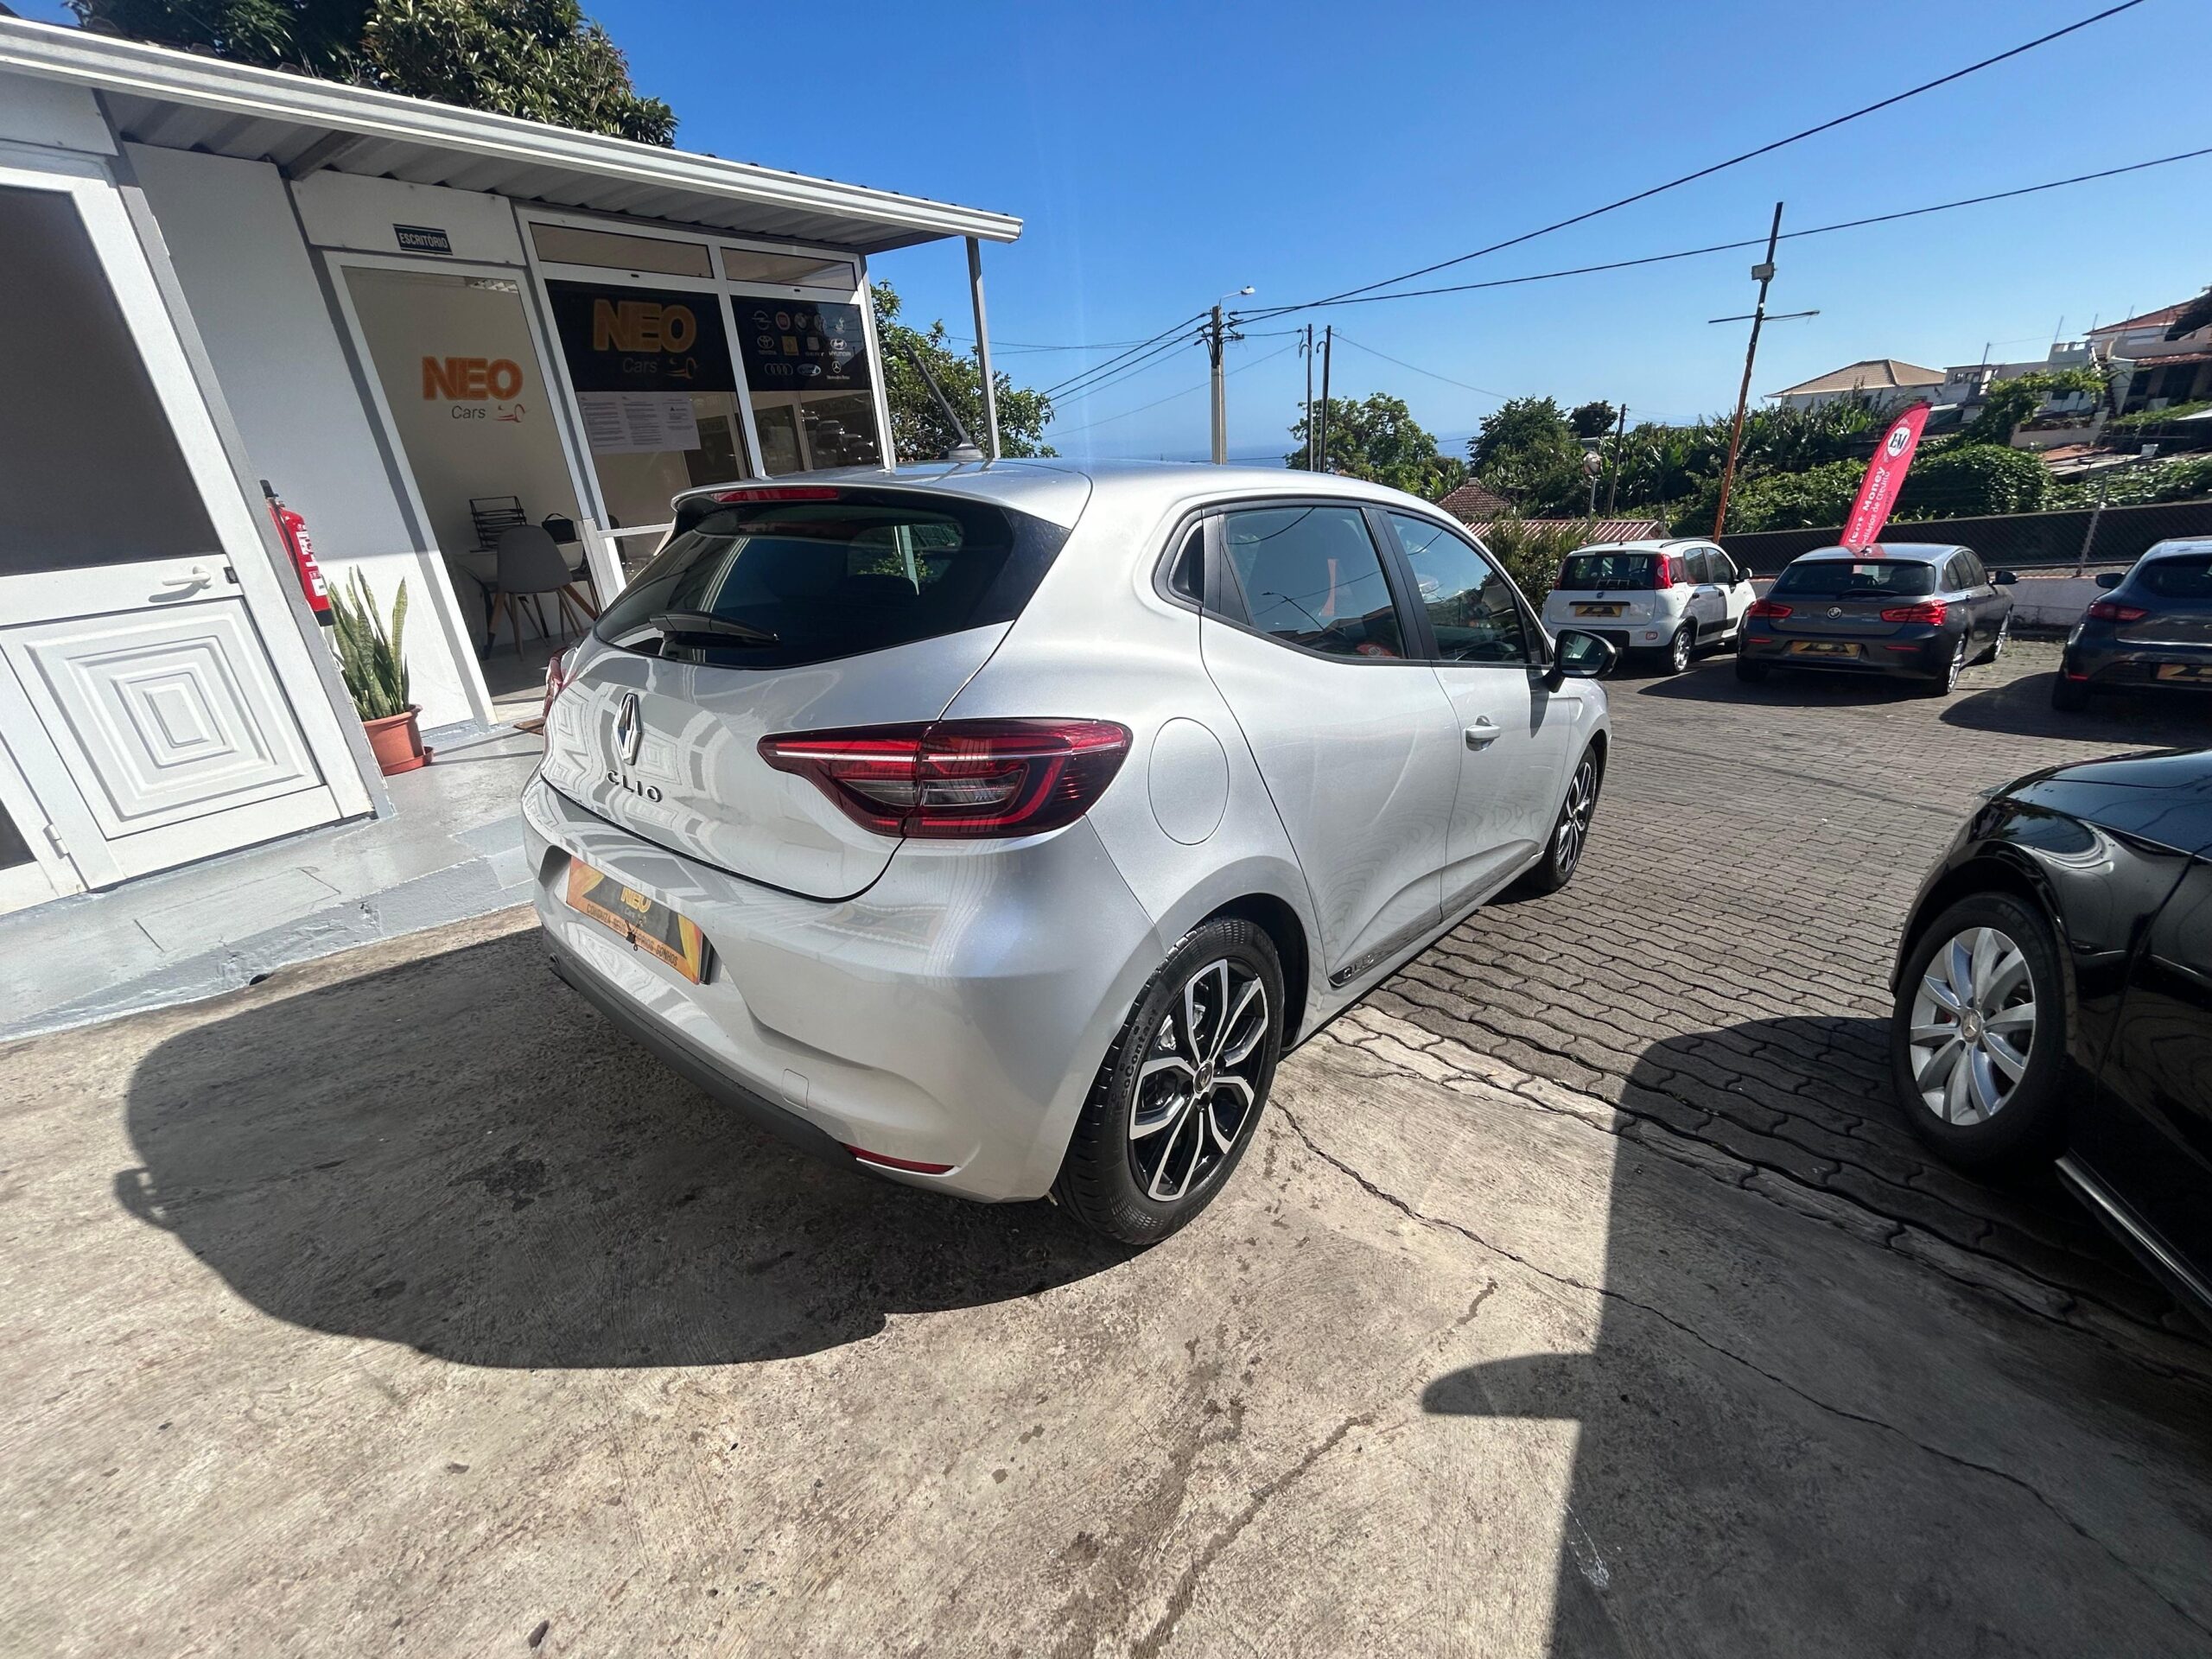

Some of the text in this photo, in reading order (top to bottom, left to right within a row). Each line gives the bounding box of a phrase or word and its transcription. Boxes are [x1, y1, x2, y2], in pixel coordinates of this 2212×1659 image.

[398, 232, 448, 249] ESCRITÓRIO
[594, 299, 696, 353] NEO
[422, 356, 524, 401] NEO
[622, 357, 658, 374] Cars
[451, 404, 486, 419] Cars
[1863, 467, 1885, 512] Money
[606, 769, 664, 803] CLIO
[656, 944, 678, 967] SONHOS
